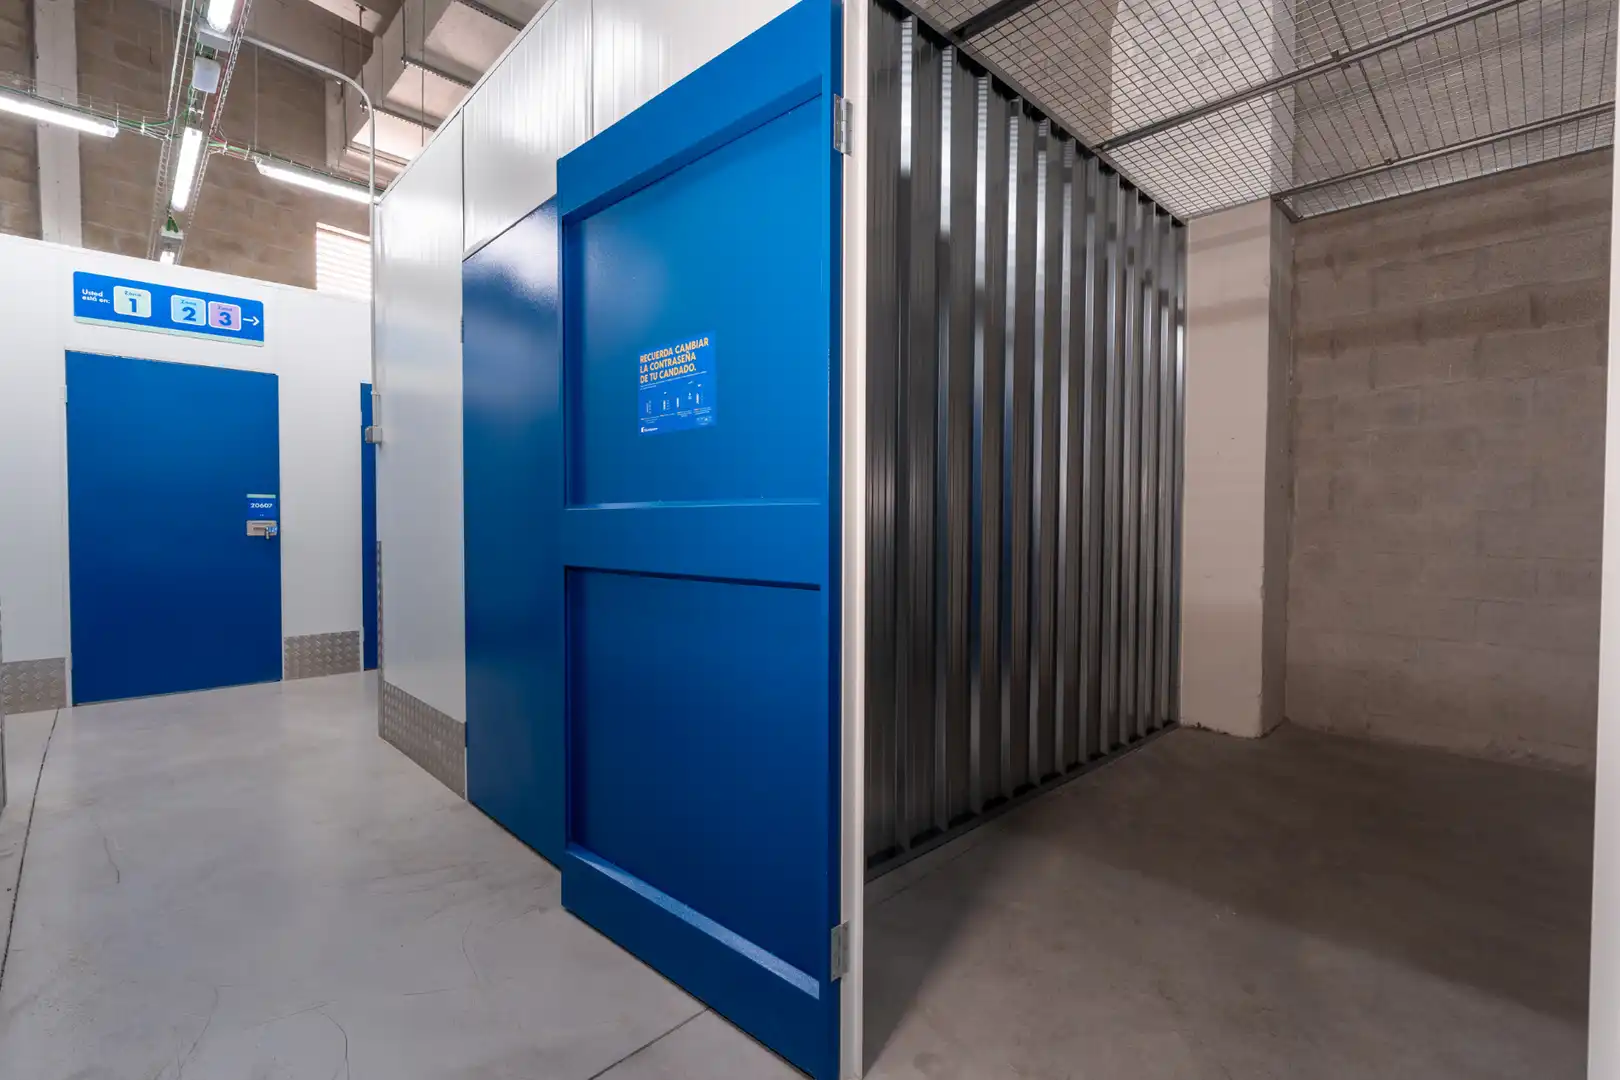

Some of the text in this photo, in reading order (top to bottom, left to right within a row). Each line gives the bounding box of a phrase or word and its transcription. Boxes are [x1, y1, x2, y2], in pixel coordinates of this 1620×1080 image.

[82, 289, 103, 297] Usted
[129, 298, 137, 313] 1
[182, 307, 196, 322] 2
[218, 311, 232, 327] 3
[640, 337, 709, 363] RECUERDA CAMBIAR
[640, 351, 696, 373] LA CONTRASEÑA
[640, 375, 648, 383] DE
[650, 372, 658, 380] TU
[659, 363, 696, 378] CANDADO.
